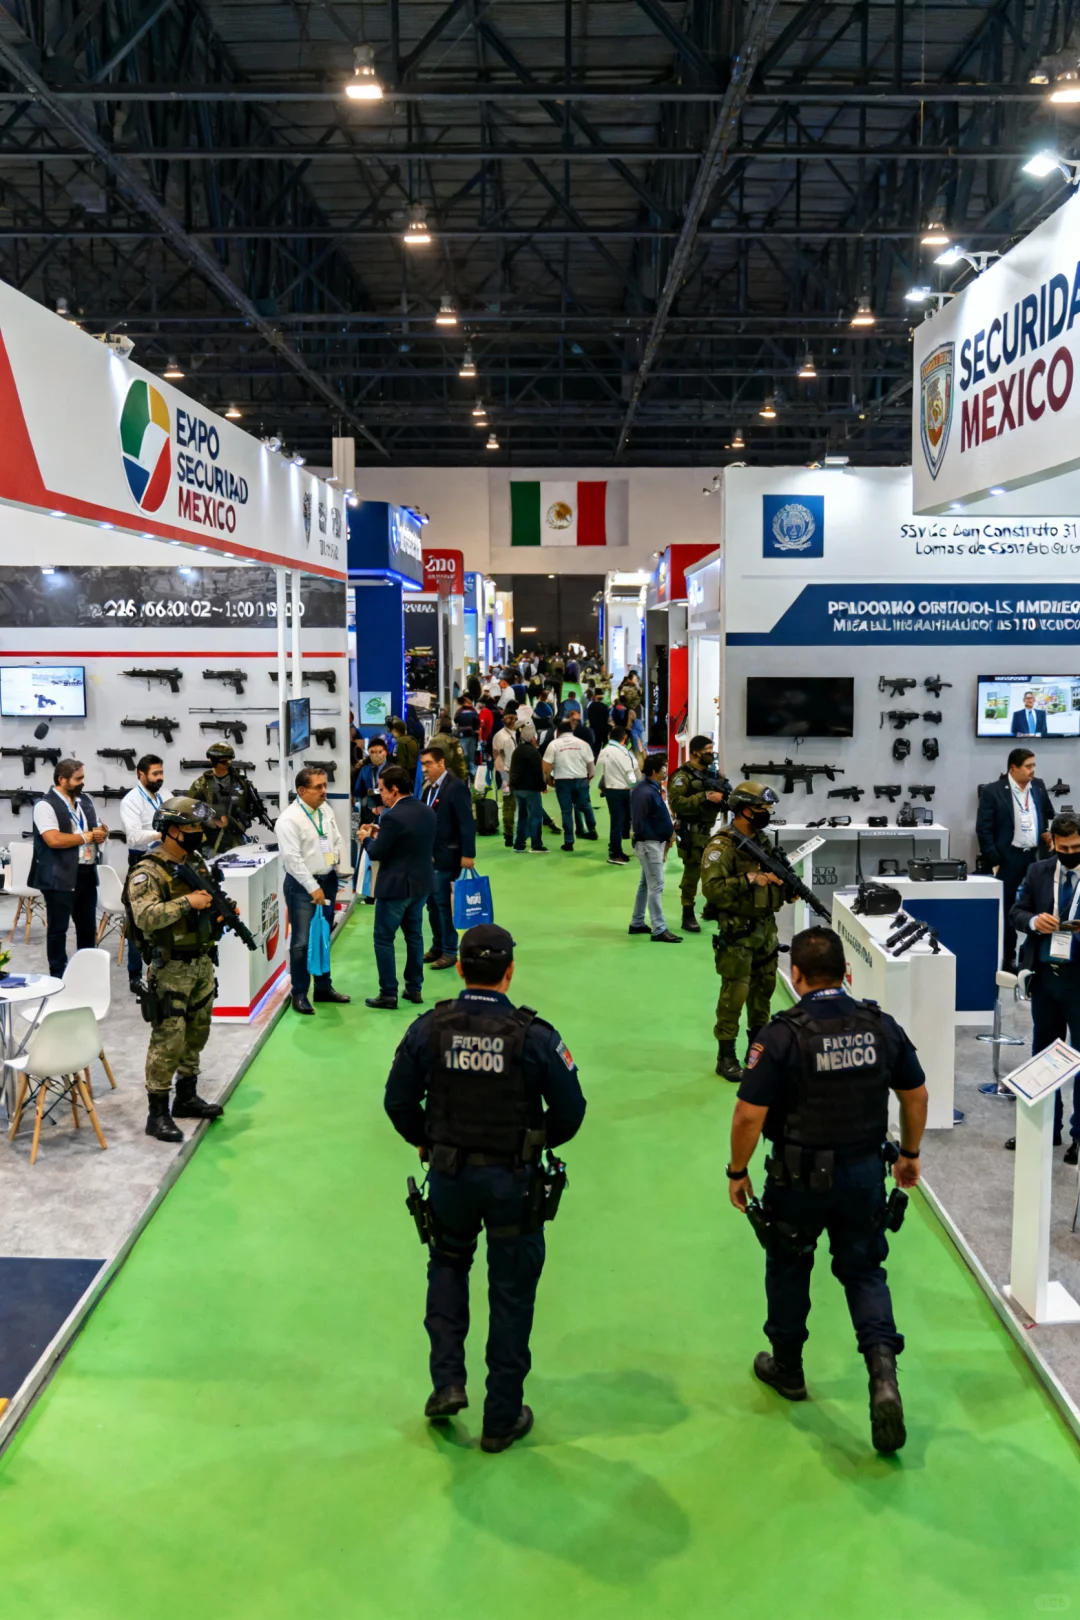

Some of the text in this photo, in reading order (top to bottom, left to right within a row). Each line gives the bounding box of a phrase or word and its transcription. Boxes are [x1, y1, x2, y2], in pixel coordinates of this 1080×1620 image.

[960, 346, 1074, 453] MEXICO
[176, 407, 220, 461] EXPO
[178, 485, 237, 534] MEXICO
[915, 541, 965, 556] Lomas
